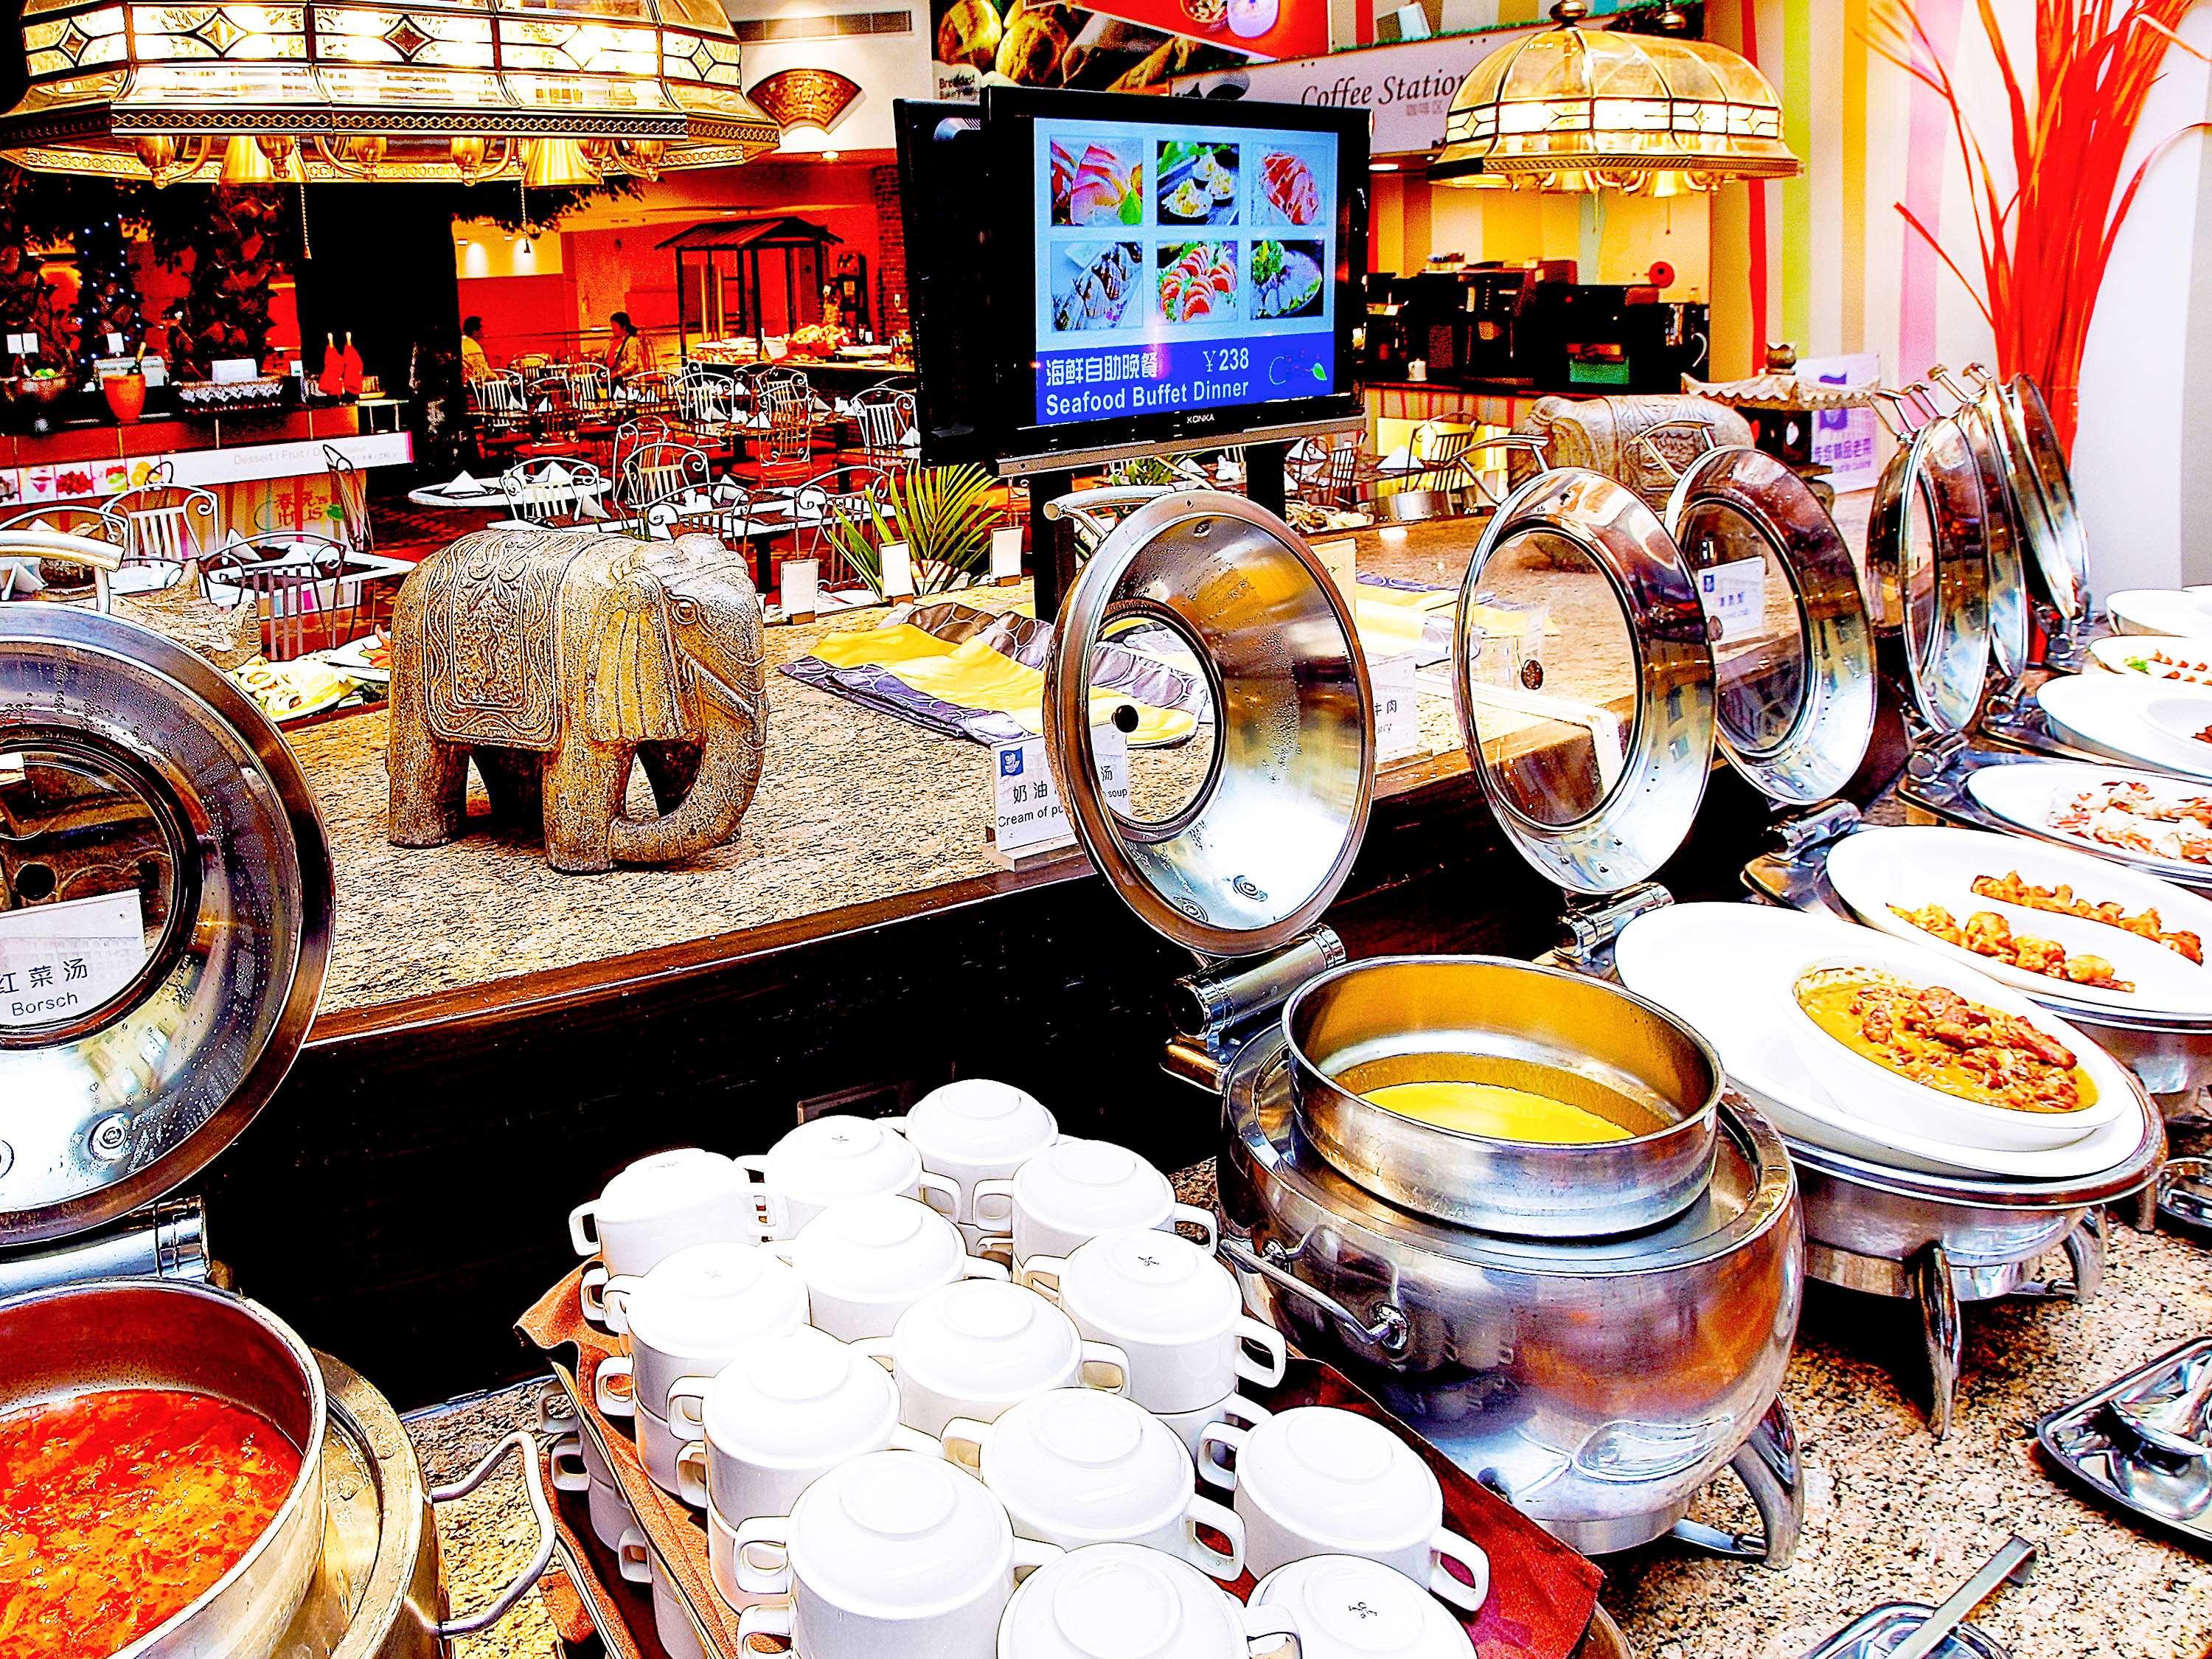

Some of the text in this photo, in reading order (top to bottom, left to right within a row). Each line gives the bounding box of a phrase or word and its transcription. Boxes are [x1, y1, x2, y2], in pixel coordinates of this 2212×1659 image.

[1301, 77, 1372, 108] Coffee
[1046, 352, 1158, 386] 海鲜自助晚餐
[1046, 380, 1249, 417] Seafood Buffet Dinner
[1186, 413, 1215, 424] KONKA
[998, 788, 1127, 827] Cream of soup
[0, 958, 88, 994] 红菜汤
[12, 992, 78, 1016] Borsch
